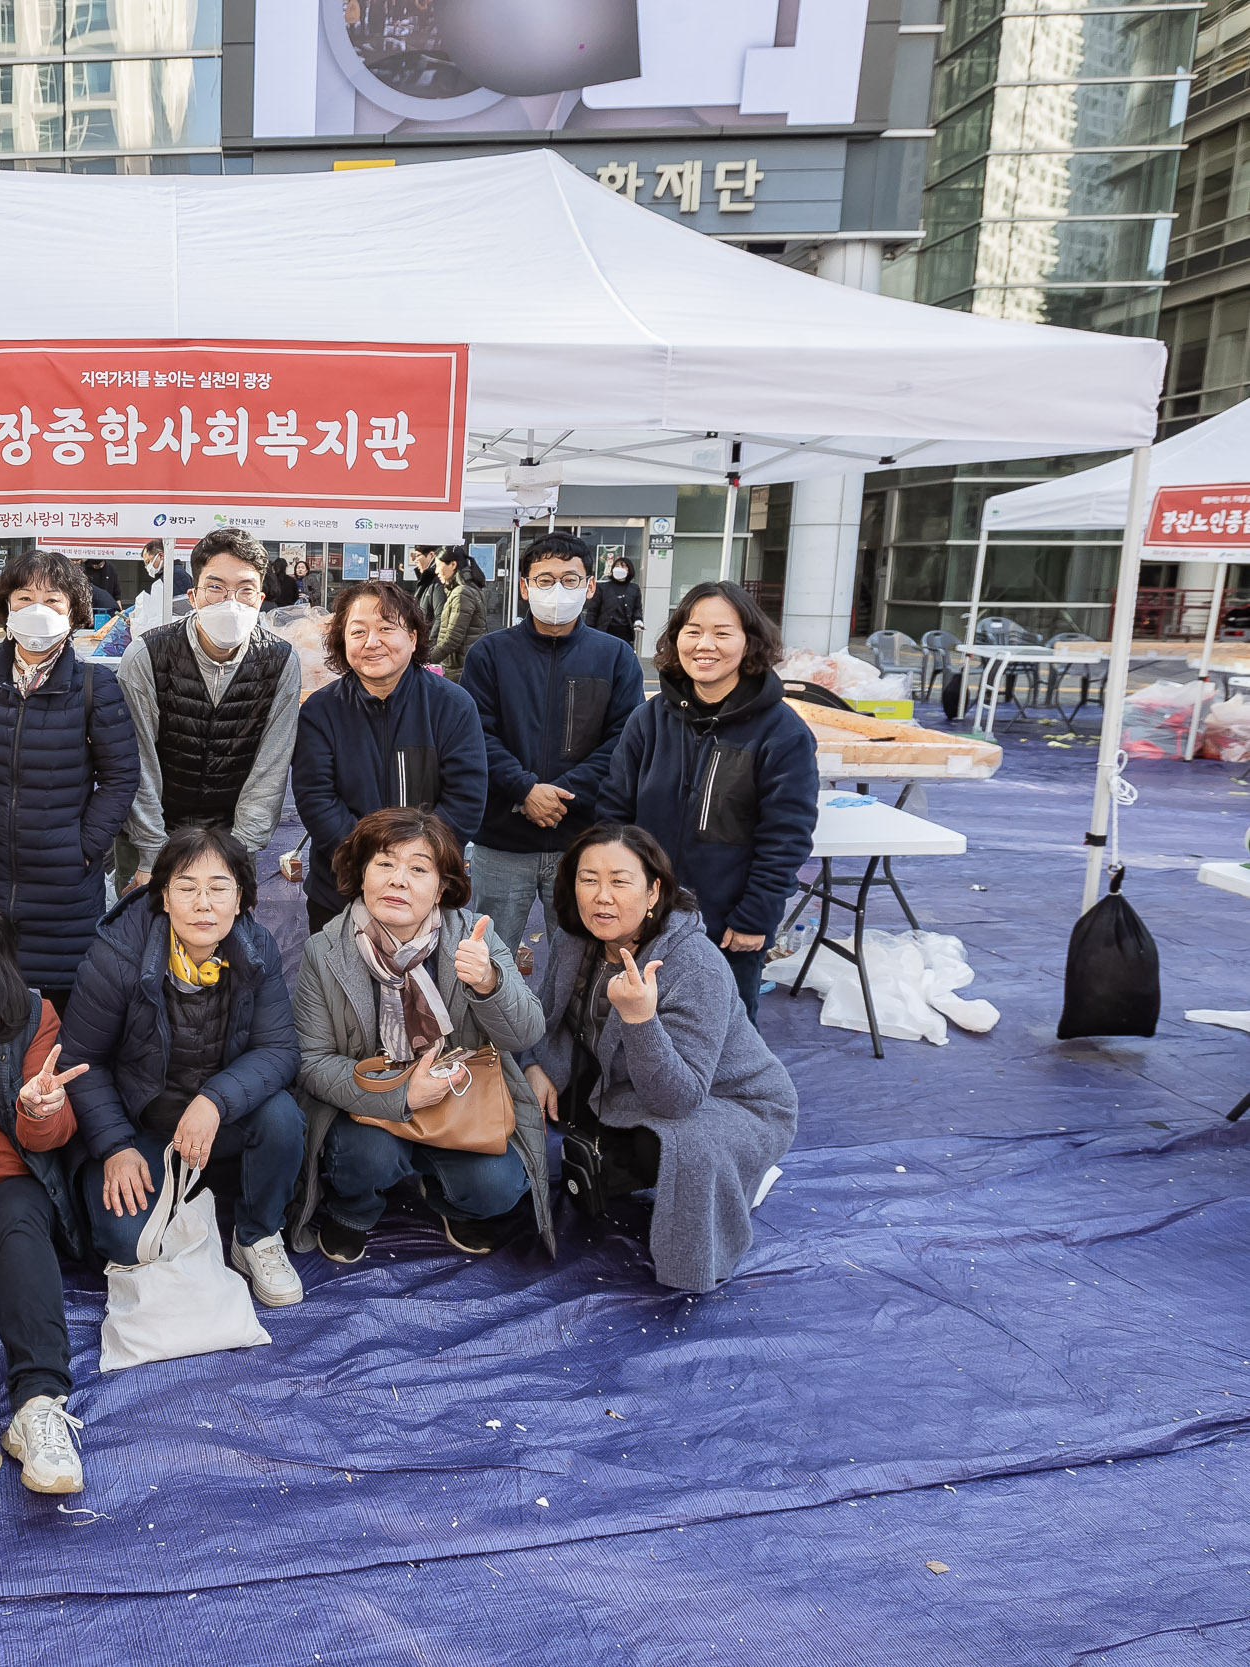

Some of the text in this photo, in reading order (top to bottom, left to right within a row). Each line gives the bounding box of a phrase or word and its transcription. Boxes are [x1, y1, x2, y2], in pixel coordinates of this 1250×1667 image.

[572, 158, 765, 214] 화재단
[81, 370, 272, 390] 지역가치를 높이는 실천의 광장
[25, 512, 64, 528] 사랑의
[68, 512, 119, 528] 김장축제
[169, 516, 196, 525] 광진구
[229, 517, 266, 526] 광진복지재단
[297, 519, 339, 529] KB 국민은행
